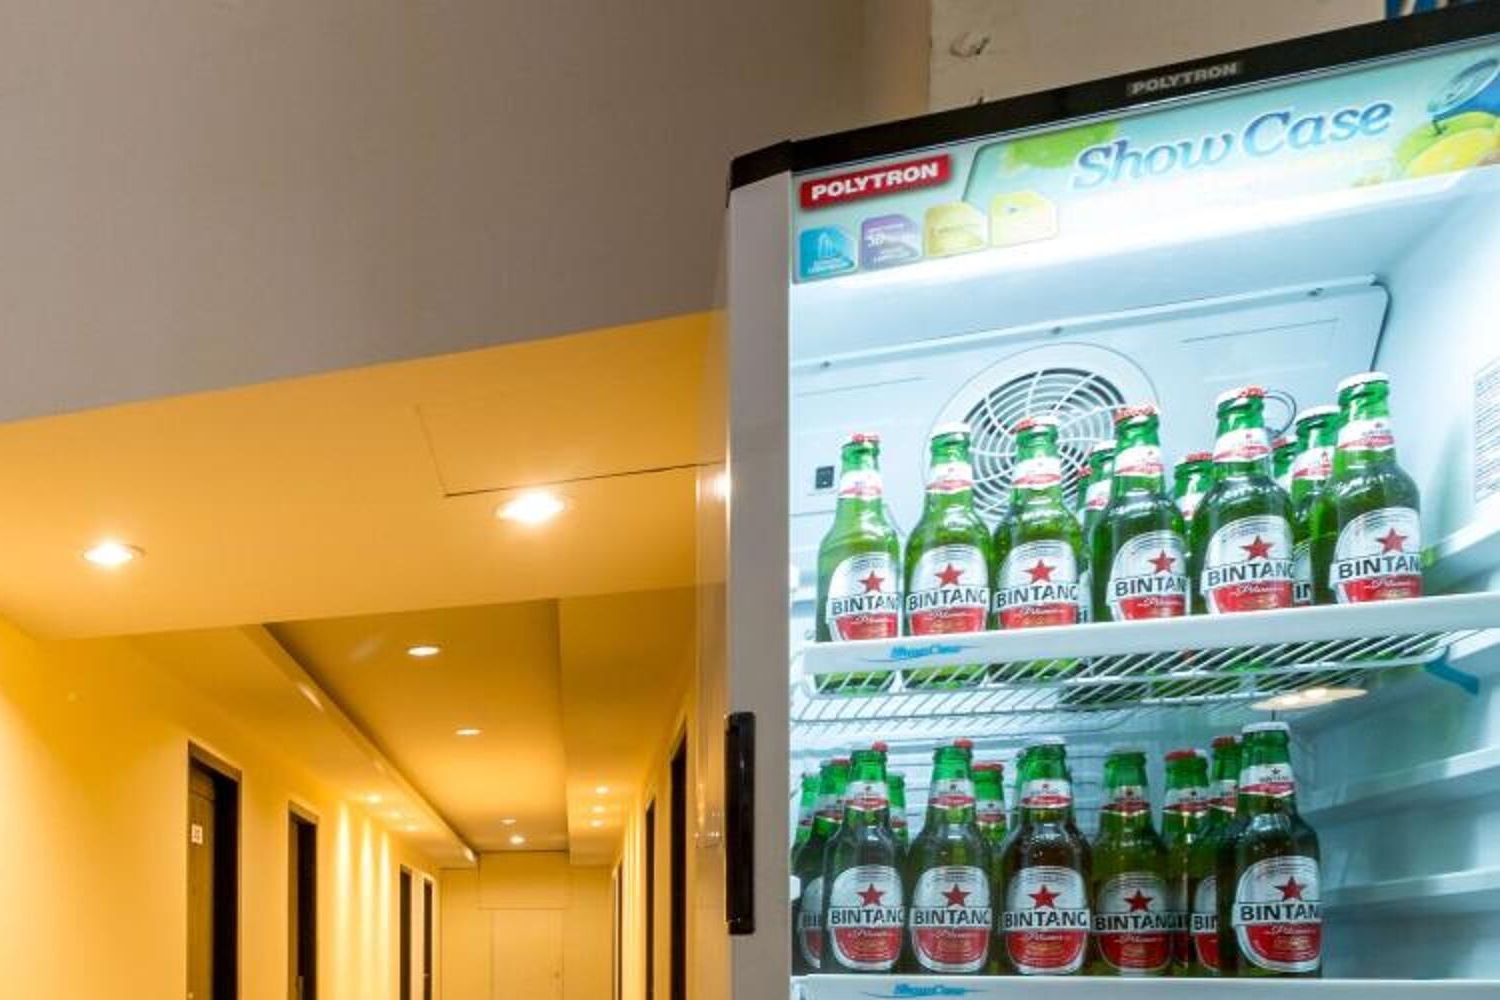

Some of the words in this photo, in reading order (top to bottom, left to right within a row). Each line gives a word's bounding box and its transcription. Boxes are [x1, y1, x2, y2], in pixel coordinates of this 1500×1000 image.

[1130, 63, 1238, 94] POLYTRON
[811, 162, 939, 199] POLYTRON
[1338, 555, 1419, 579] BINTAN
[1115, 578, 1185, 597] BINTAN
[832, 595, 897, 615] BINTAN
[1240, 904, 1317, 921] BINTAN
